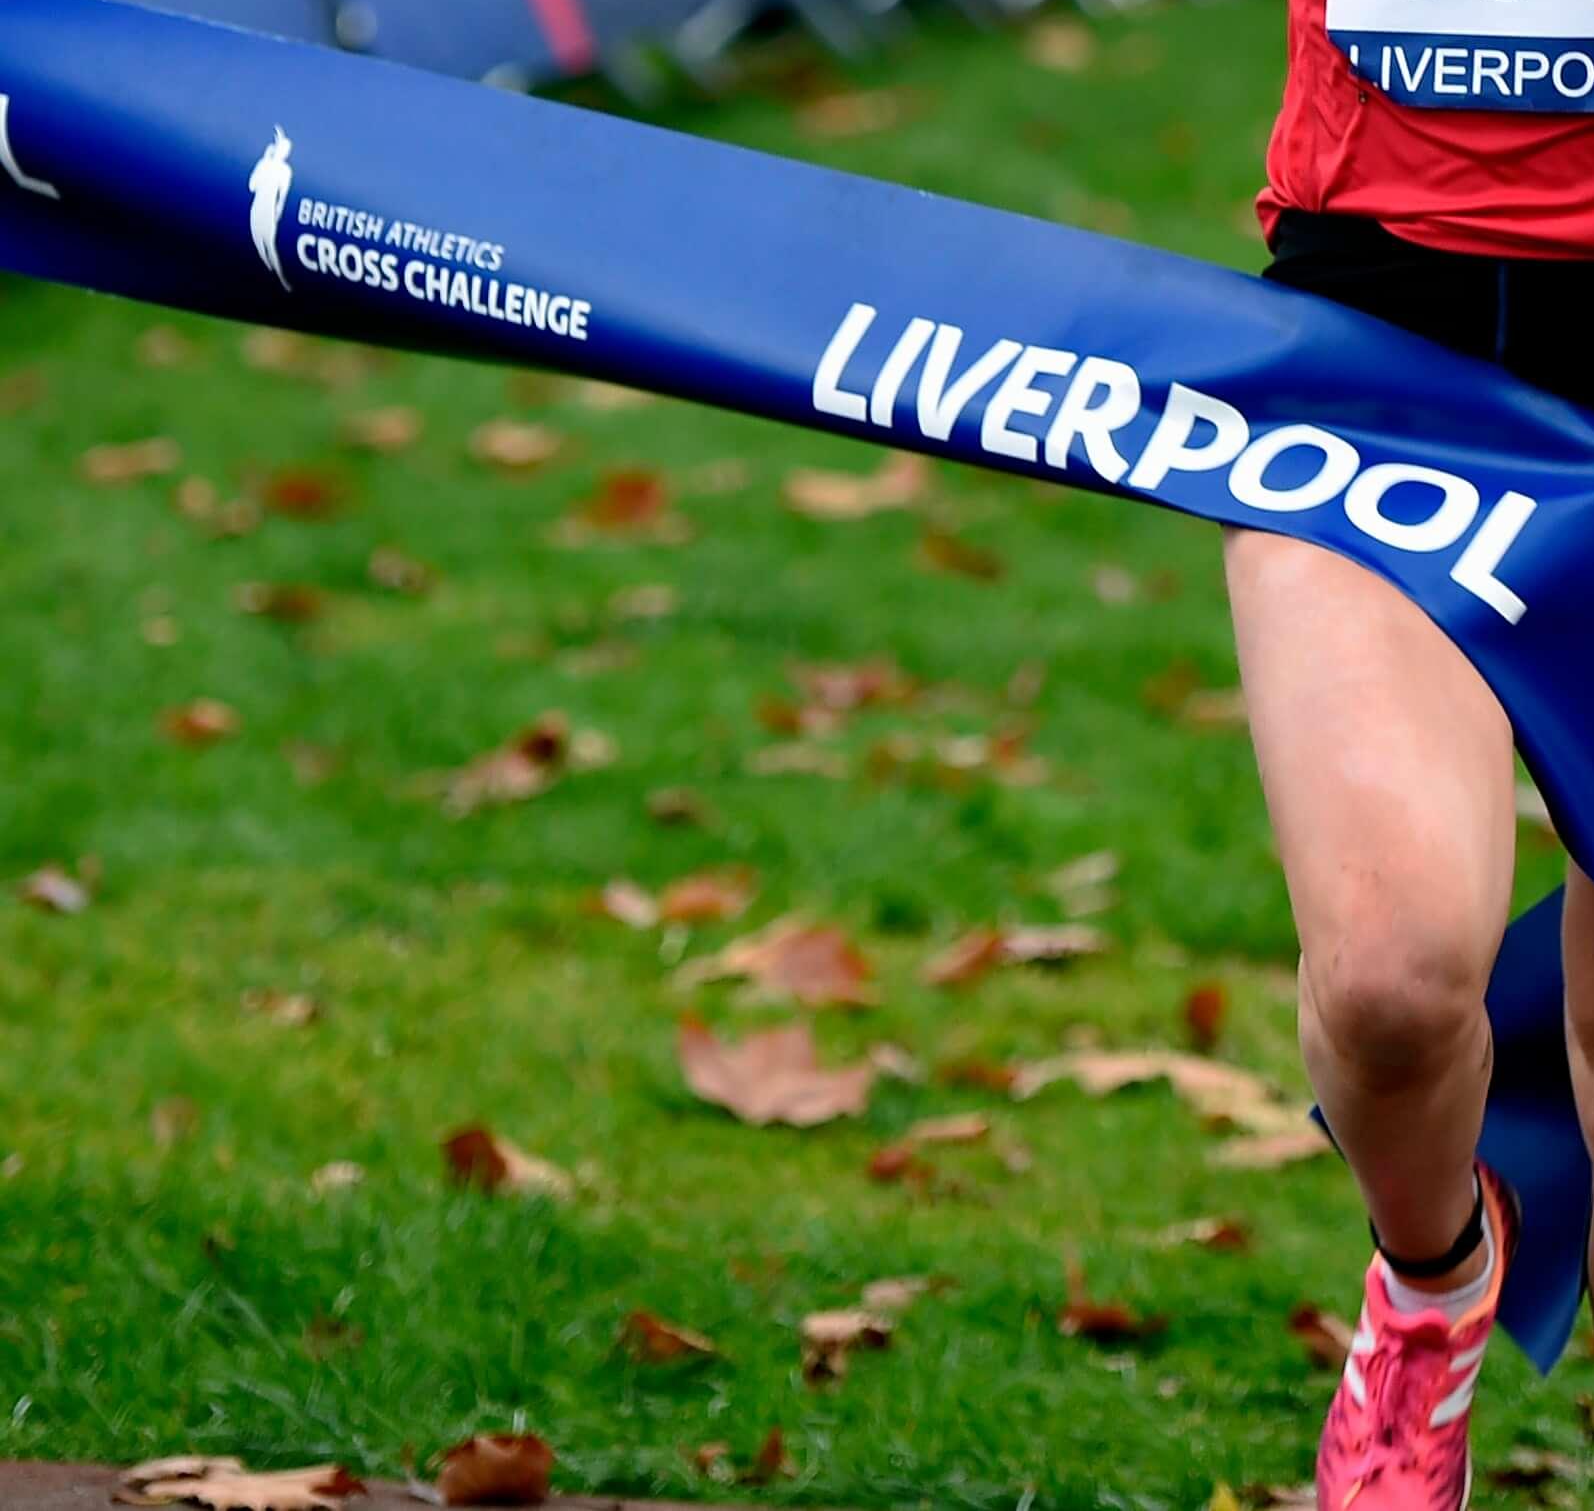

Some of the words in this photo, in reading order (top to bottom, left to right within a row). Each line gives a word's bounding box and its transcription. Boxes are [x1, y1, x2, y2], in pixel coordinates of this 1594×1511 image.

[296, 233, 400, 292] CROSS
[404, 259, 592, 341] CHALLENGE
[297, 197, 385, 243] BRITISH
[385, 220, 505, 272] ATHLETICS
[811, 302, 1539, 627] LIVERPOOL
